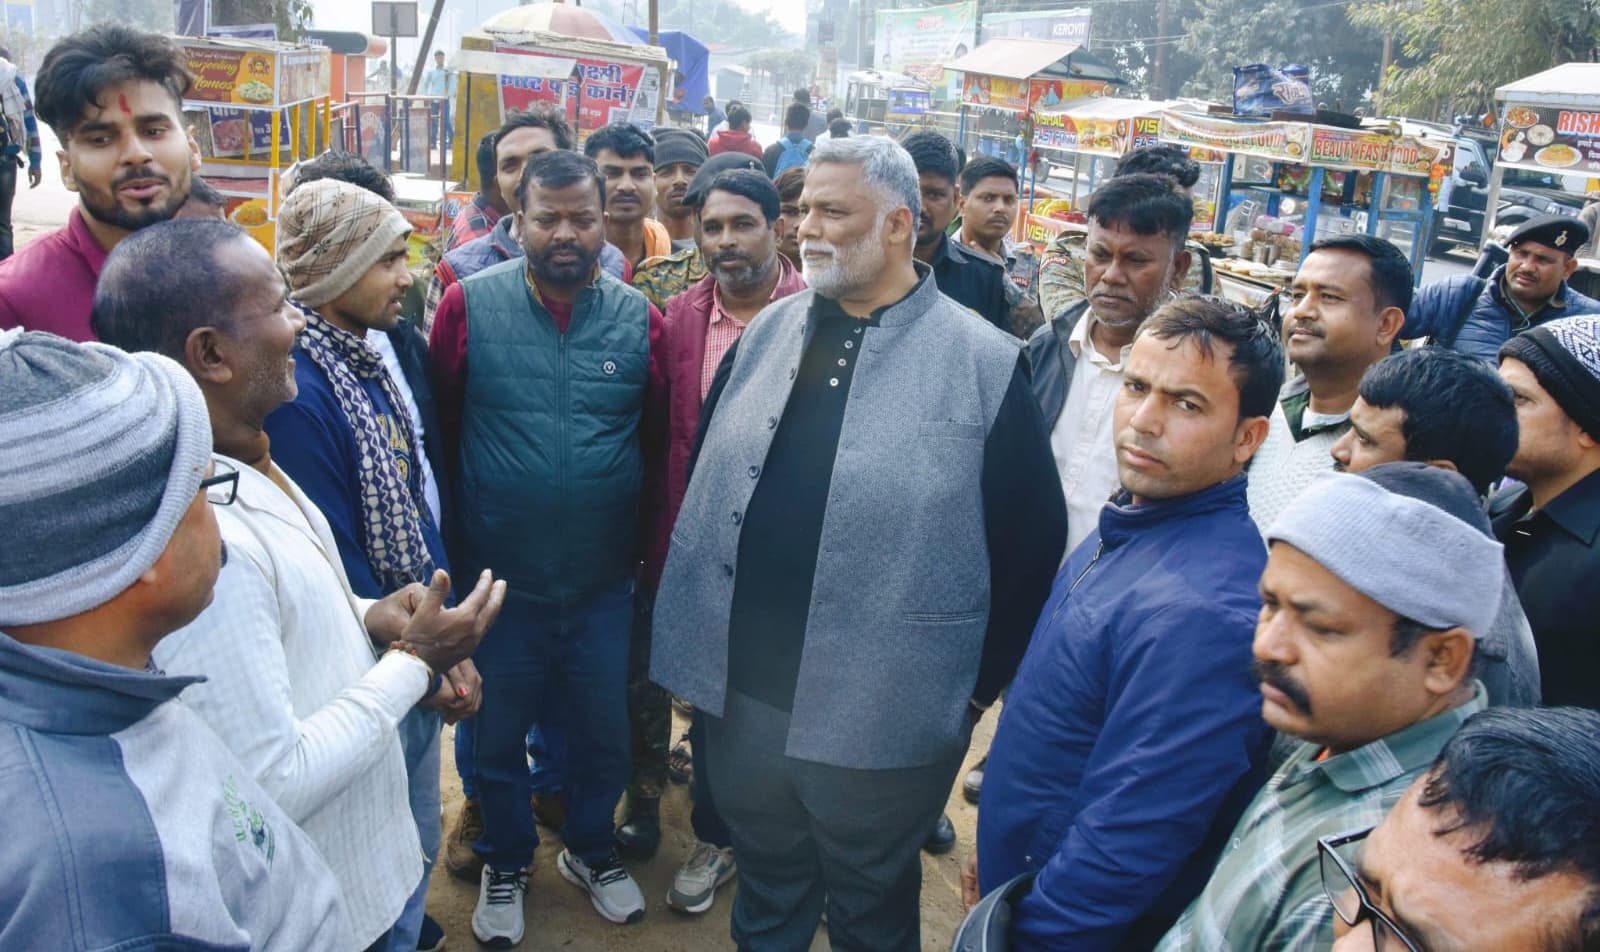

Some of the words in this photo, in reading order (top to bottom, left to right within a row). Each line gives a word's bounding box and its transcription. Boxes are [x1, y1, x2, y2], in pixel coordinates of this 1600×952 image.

[1053, 22, 1086, 36] KEROVIT
[1035, 112, 1065, 128] VISHAL
[1557, 111, 1600, 137] RISH
[1034, 128, 1054, 146] FAST
[1314, 138, 1358, 159] BEAUTY
[1359, 143, 1386, 162] FAST
